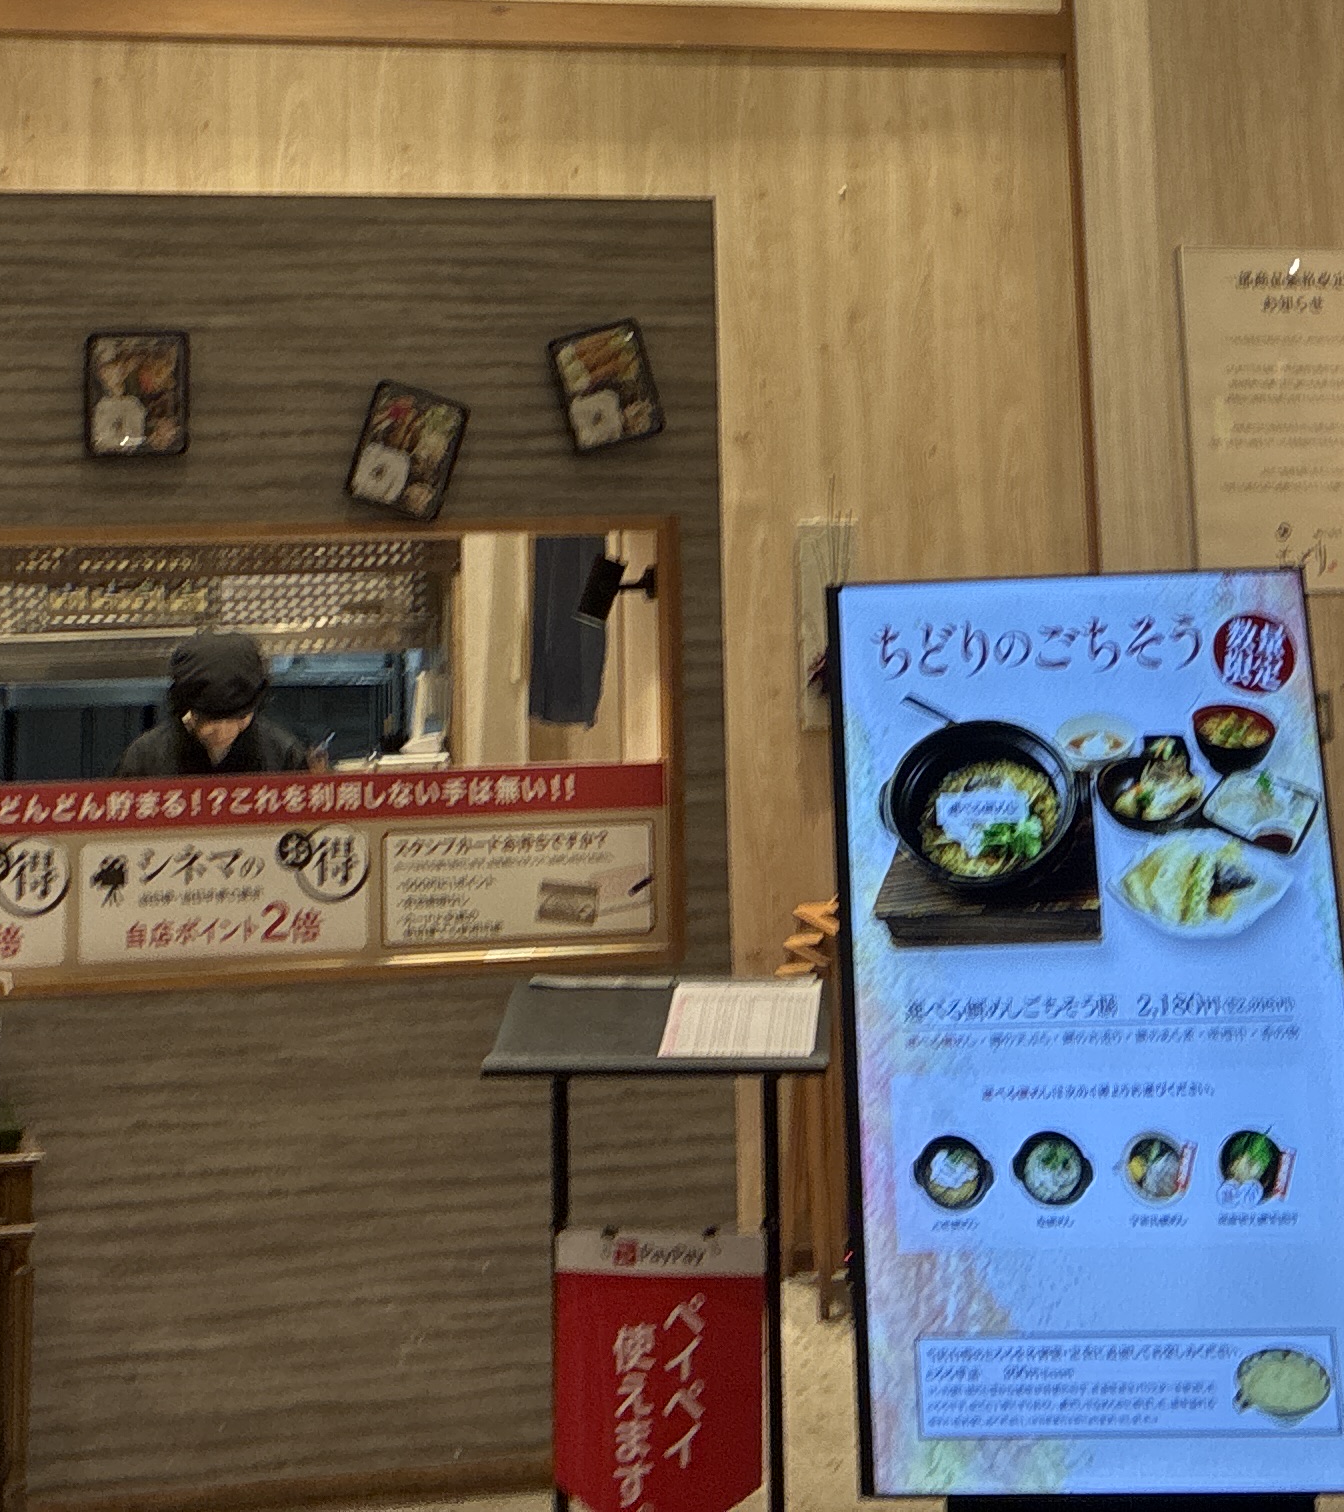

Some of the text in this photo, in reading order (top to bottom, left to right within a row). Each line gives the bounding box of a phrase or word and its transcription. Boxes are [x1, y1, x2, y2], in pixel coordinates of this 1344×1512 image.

[870, 612, 1203, 680] ちどりのごちそう
[137, 844, 266, 886] シネマの
[612, 1322, 657, 1512] 使えます
[662, 1292, 707, 1469] ペイペイ
